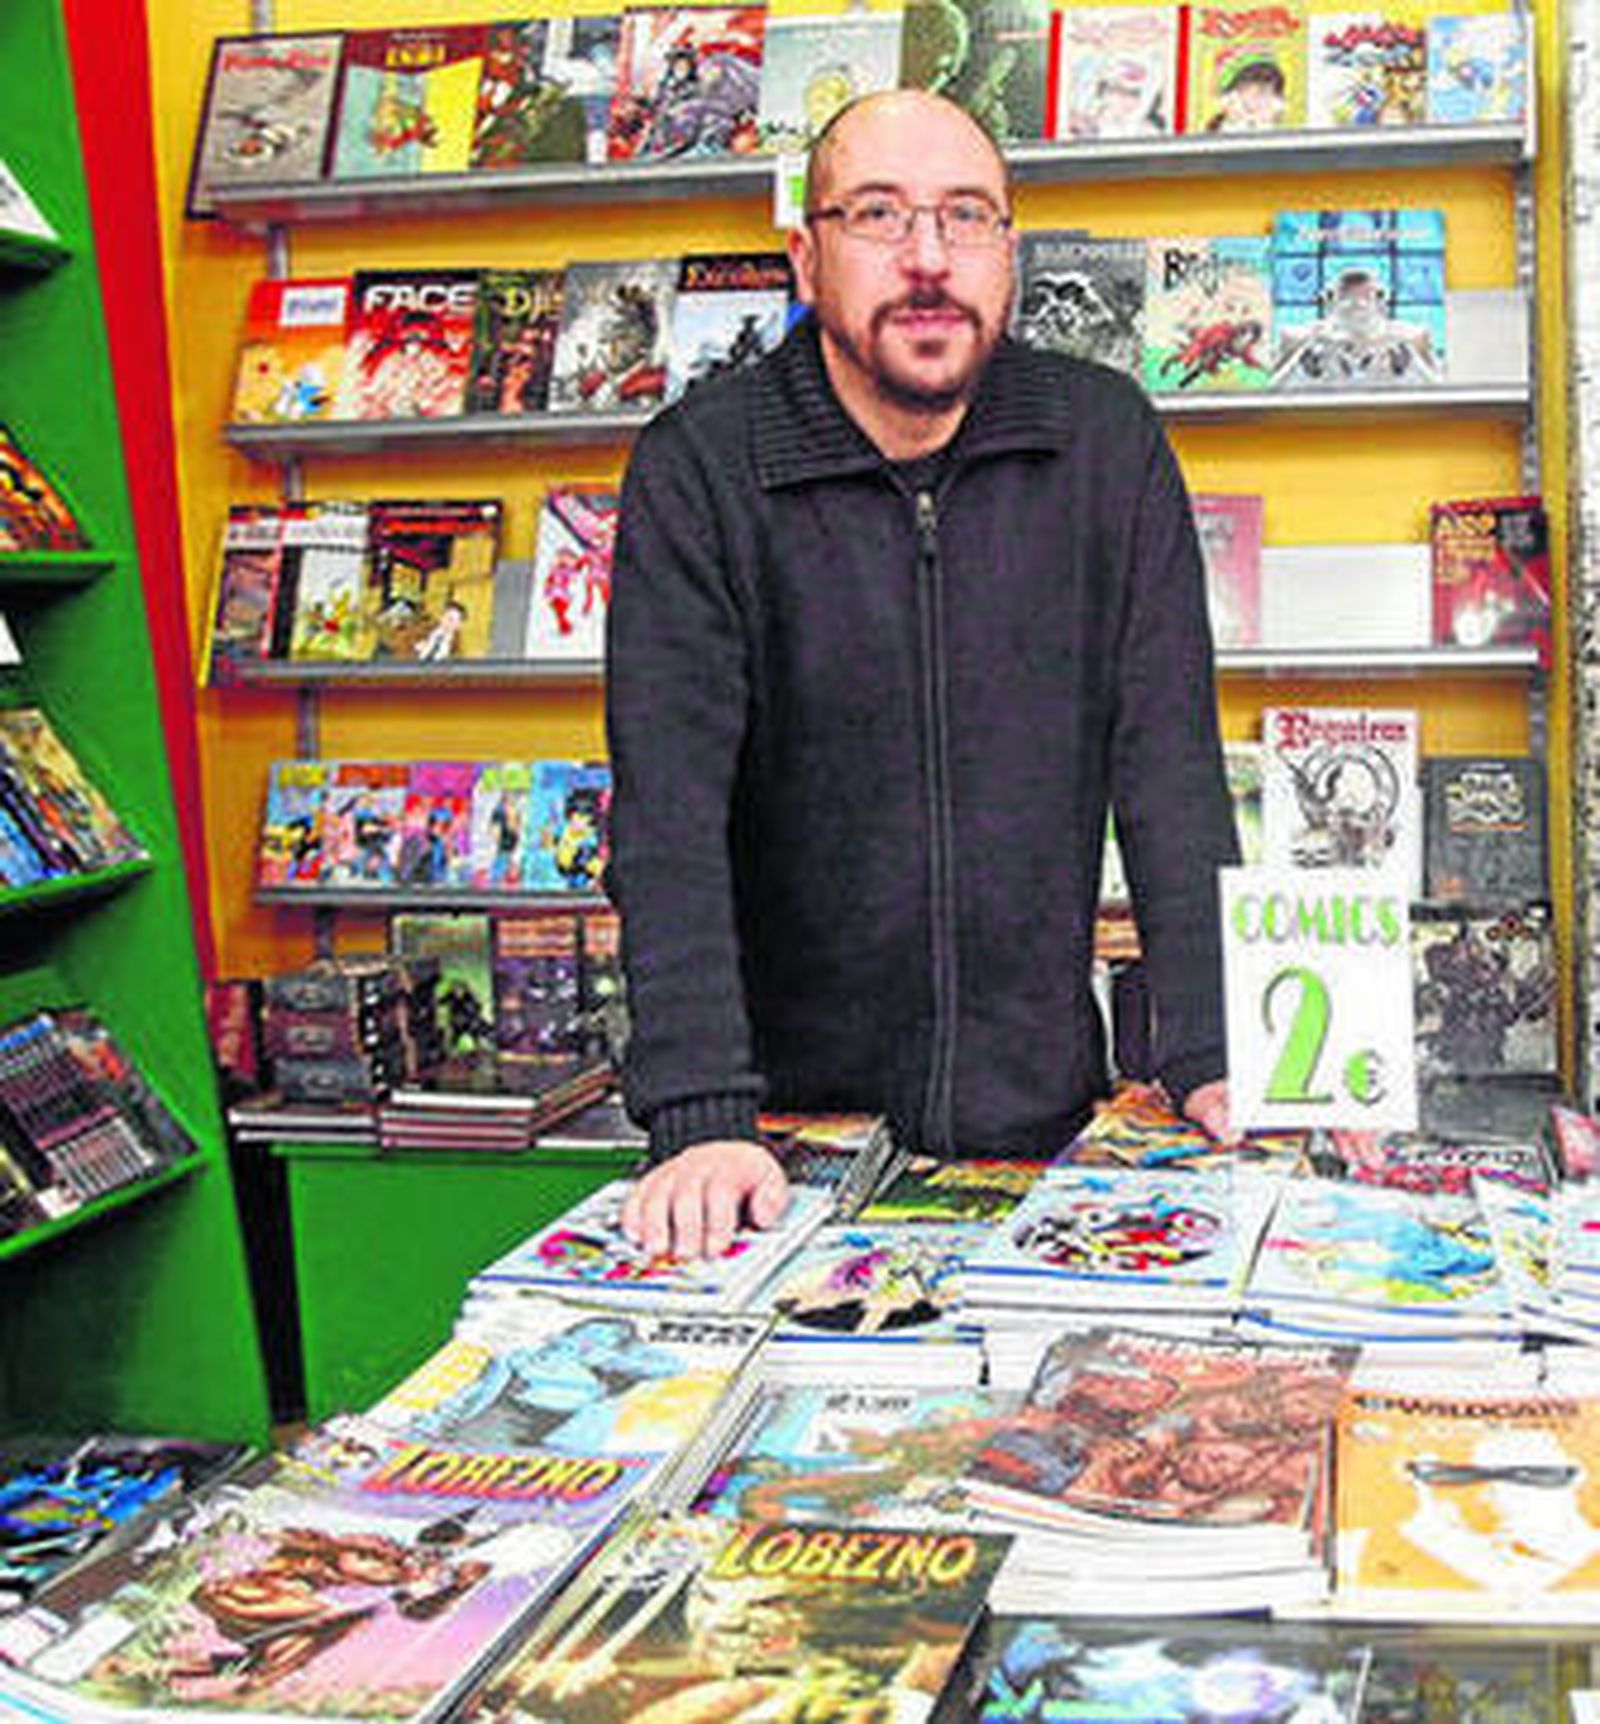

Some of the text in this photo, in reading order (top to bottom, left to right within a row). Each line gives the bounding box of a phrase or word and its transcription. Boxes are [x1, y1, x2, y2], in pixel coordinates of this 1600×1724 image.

[364, 284, 477, 313] FACE
[1231, 892, 1400, 949] COMICS
[366, 1442, 625, 1499] LOBEZNO
[710, 1523, 980, 1588] LOBEZNO
